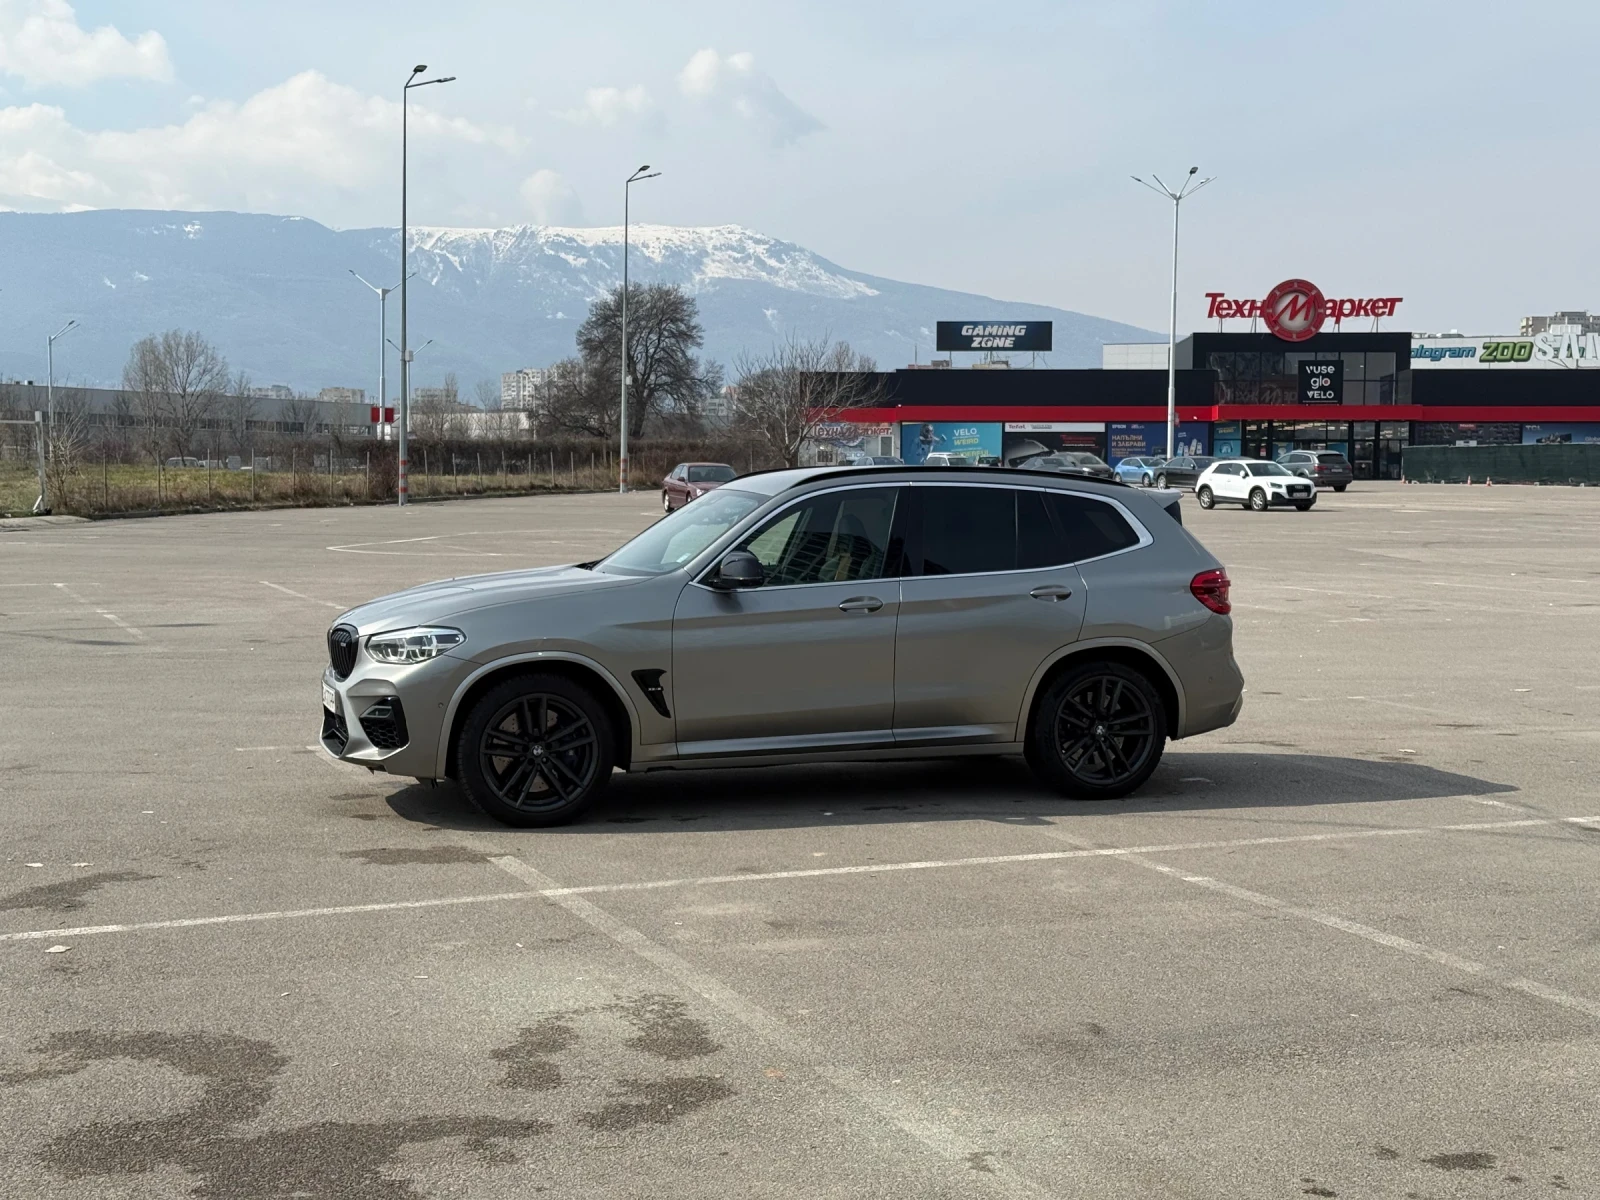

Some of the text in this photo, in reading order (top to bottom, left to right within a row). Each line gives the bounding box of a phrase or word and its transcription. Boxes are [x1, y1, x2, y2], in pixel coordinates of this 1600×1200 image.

[961, 325, 1027, 336] GAMING
[971, 337, 1016, 348] ZONE
[1480, 341, 1534, 363] ZOO
[1310, 375, 1331, 389] glo
[1306, 390, 1335, 399] VELO
[953, 427, 978, 437] VELO
